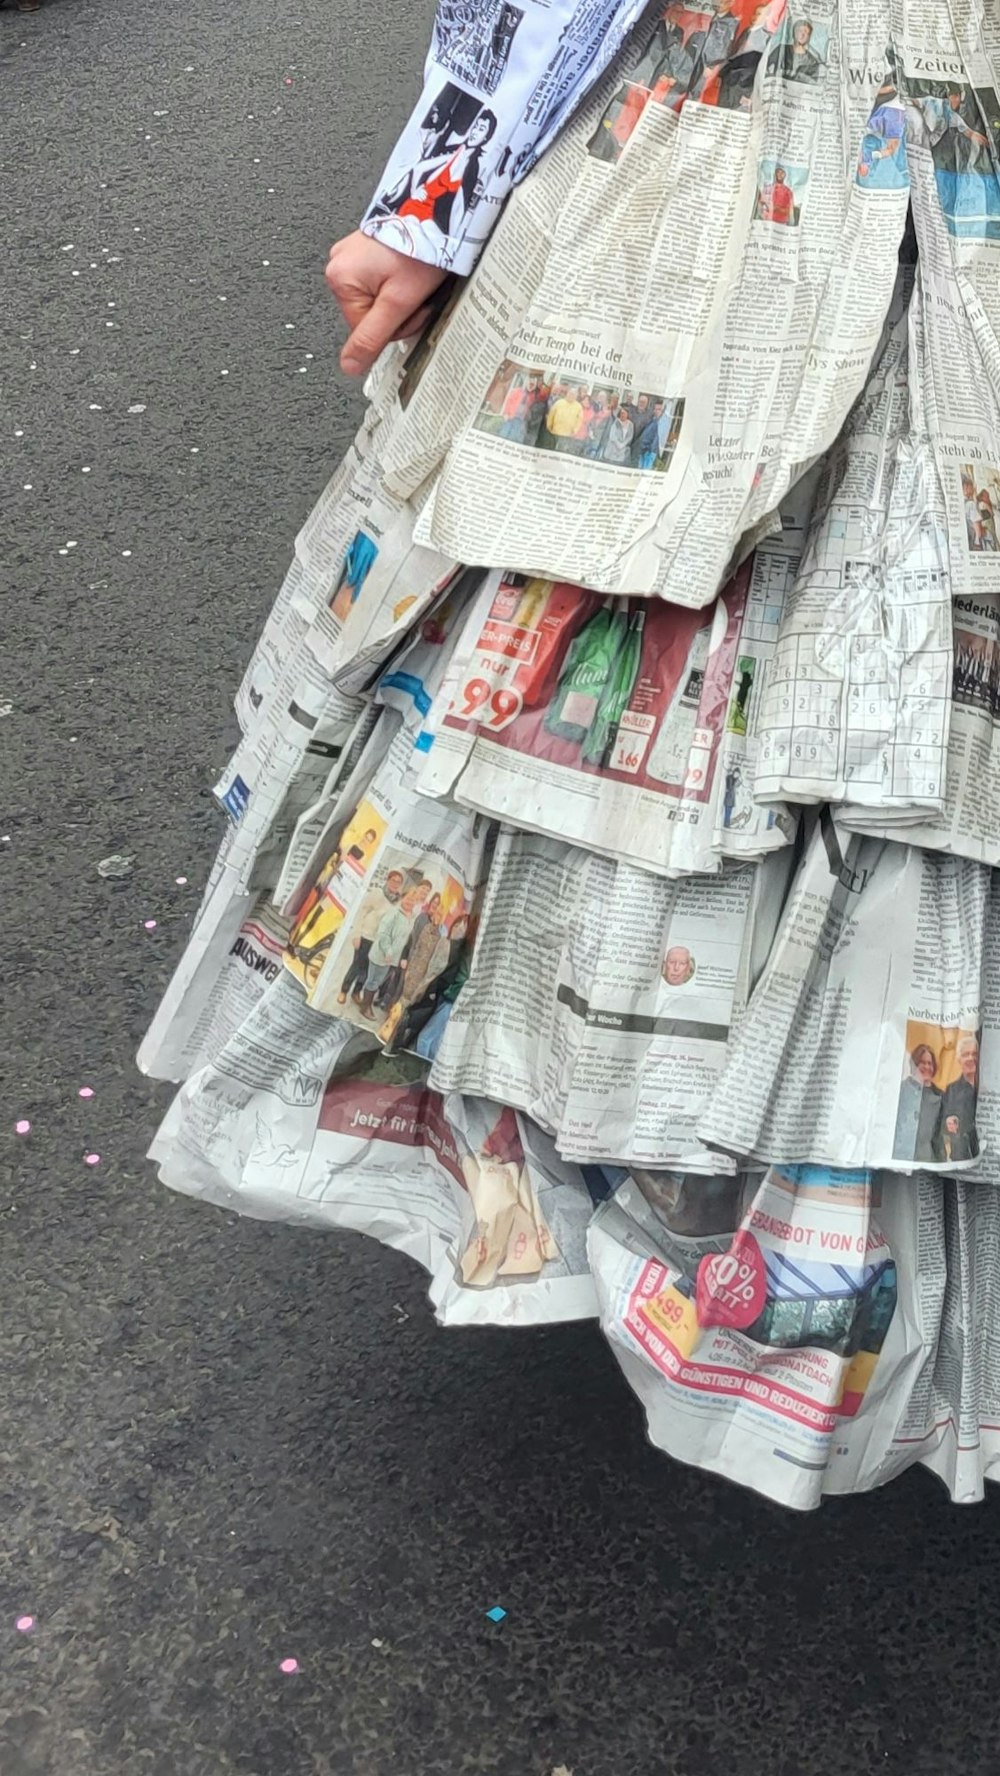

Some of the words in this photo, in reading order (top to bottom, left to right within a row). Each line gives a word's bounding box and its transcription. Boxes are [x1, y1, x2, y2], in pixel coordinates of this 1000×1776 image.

[580, 341, 601, 358] bei
[480, 656, 509, 676] nur
[819, 1231, 853, 1252] VON
